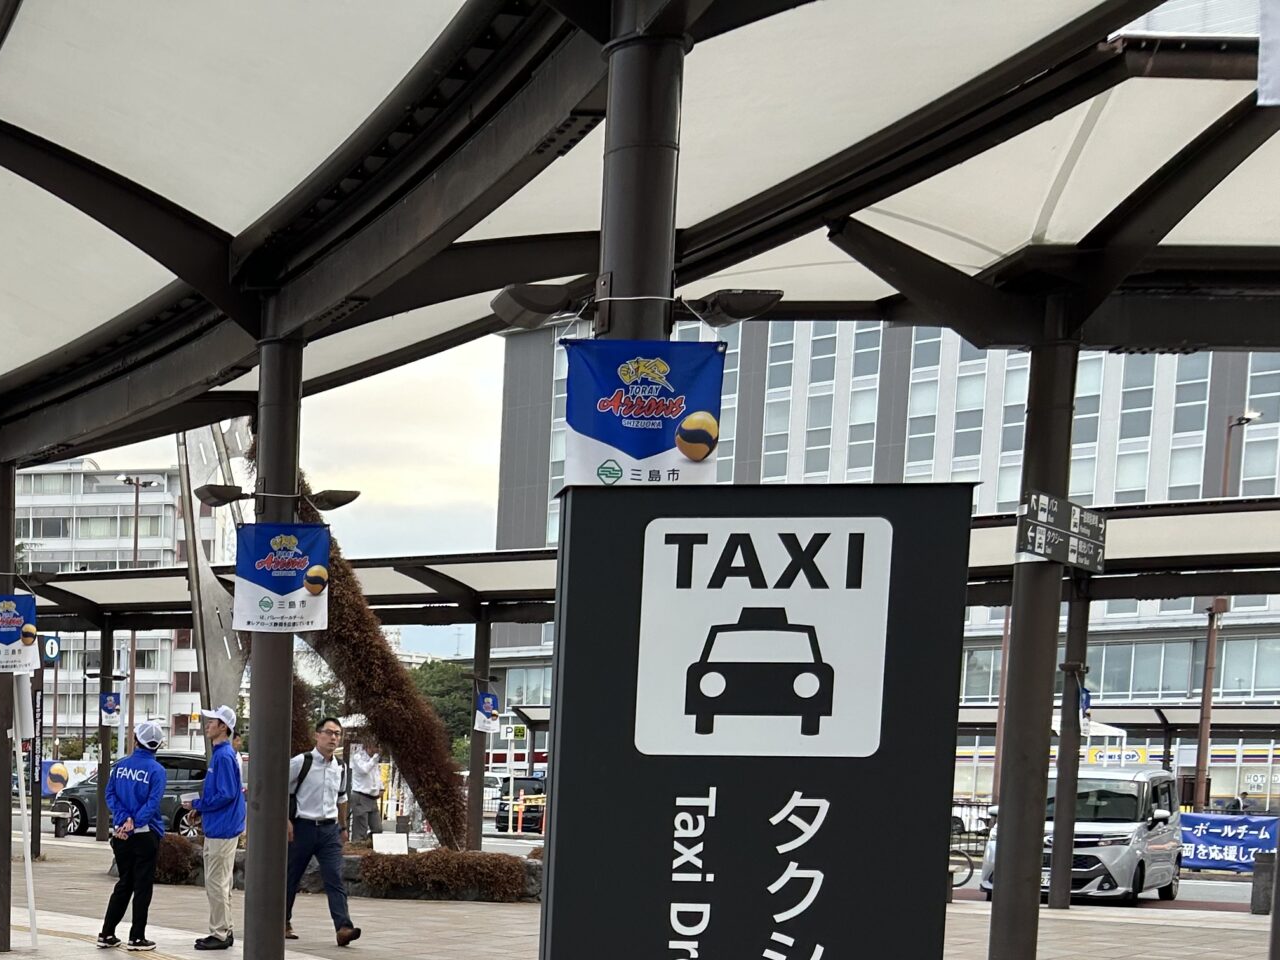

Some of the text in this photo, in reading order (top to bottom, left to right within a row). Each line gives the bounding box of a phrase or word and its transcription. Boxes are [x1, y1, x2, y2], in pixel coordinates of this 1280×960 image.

[629, 385, 661, 396] TORAY
[597, 389, 686, 419] Arrows
[622, 419, 662, 429] SHIZUOKA
[630, 468, 680, 482] 三島市
[1048, 499, 1058, 513] バス
[1046, 530, 1064, 544] タクシー
[665, 533, 864, 589] TAXI
[277, 600, 307, 609] 三島市
[116, 767, 149, 784] FANCL
[1246, 775, 1265, 783] HOT
[671, 786, 718, 883] Taxi
